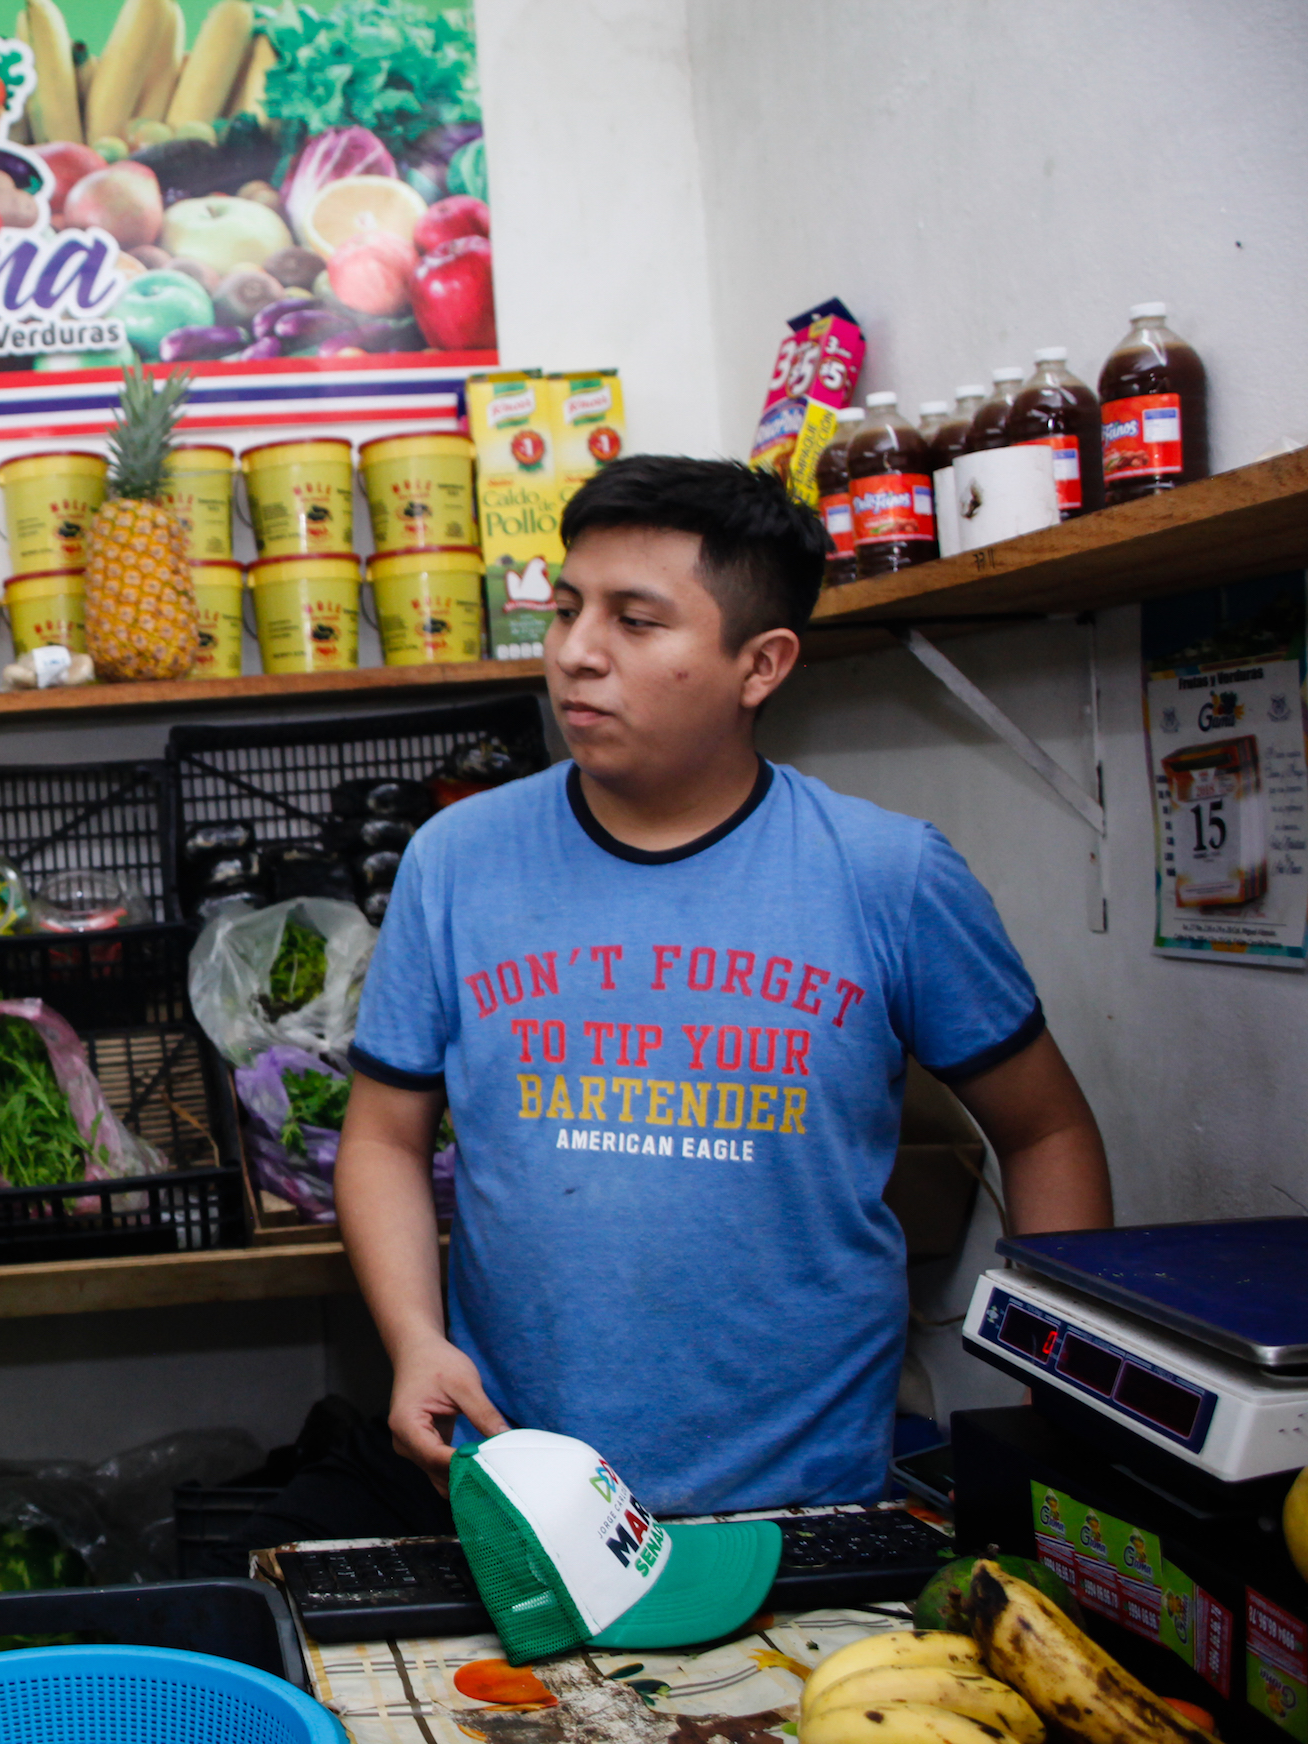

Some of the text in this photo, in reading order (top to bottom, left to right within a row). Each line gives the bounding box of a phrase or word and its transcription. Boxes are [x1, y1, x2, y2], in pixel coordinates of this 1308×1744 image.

[824, 335, 839, 355] 3
[819, 360, 845, 389] $5
[483, 486, 540, 507] Caldo
[537, 498, 555, 512] de
[485, 506, 558, 537] Pollo
[1179, 668, 1264, 689] Frutas y Verduras
[1198, 702, 1236, 732] Gama
[1190, 798, 1227, 851] 15
[463, 944, 867, 1029] DON'T FORGET
[510, 1018, 811, 1076] TO TIP YOUR
[516, 1073, 808, 1135] BARTENDER
[555, 1127, 754, 1162] AMERICAN EAGLE
[1041, 1330, 1059, 1355] 0
[596, 1510, 618, 1539] JORGE
